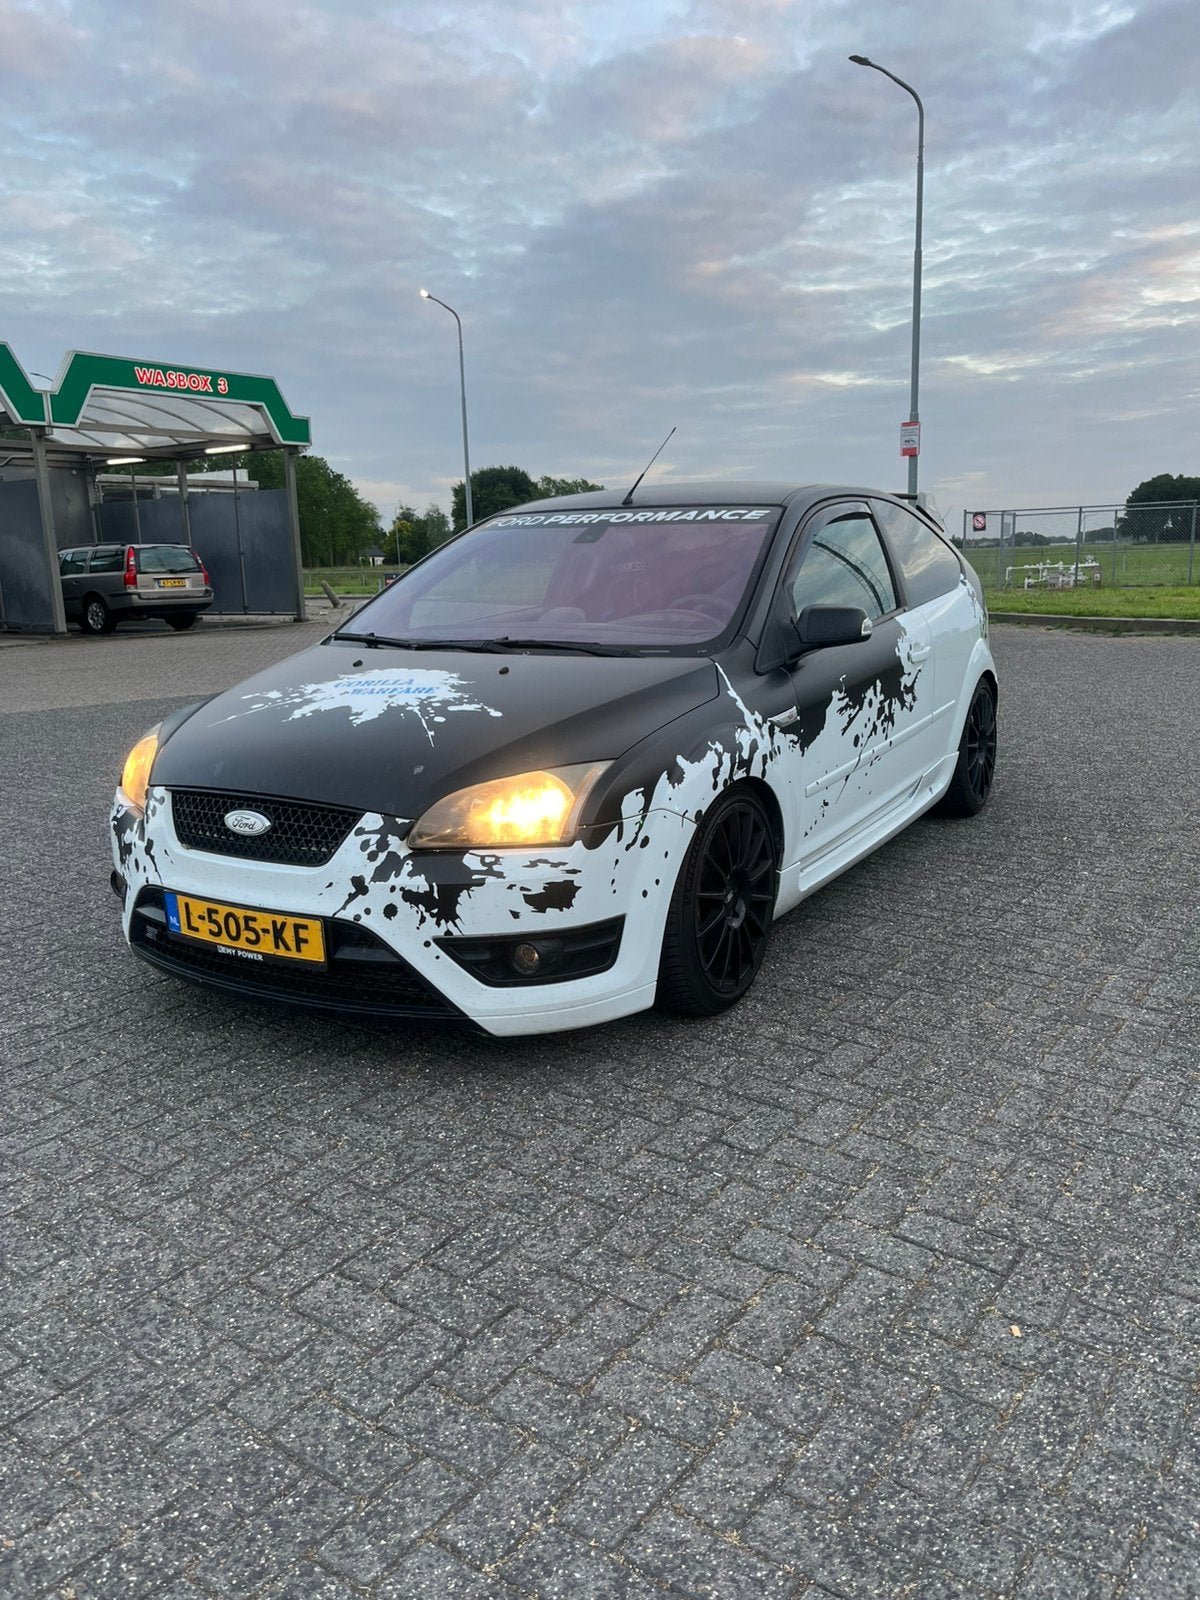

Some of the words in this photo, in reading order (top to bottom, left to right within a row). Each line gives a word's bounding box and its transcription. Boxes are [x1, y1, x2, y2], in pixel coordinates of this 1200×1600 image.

[134, 366, 213, 392] WASBOX
[217, 377, 229, 394] 3
[485, 516, 546, 528] FORD
[542, 509, 771, 526] PERFORMANCE
[232, 815, 257, 830] Ford
[169, 915, 180, 927] NL
[184, 901, 310, 953] L-505-KF
[236, 949, 264, 962] POWER
